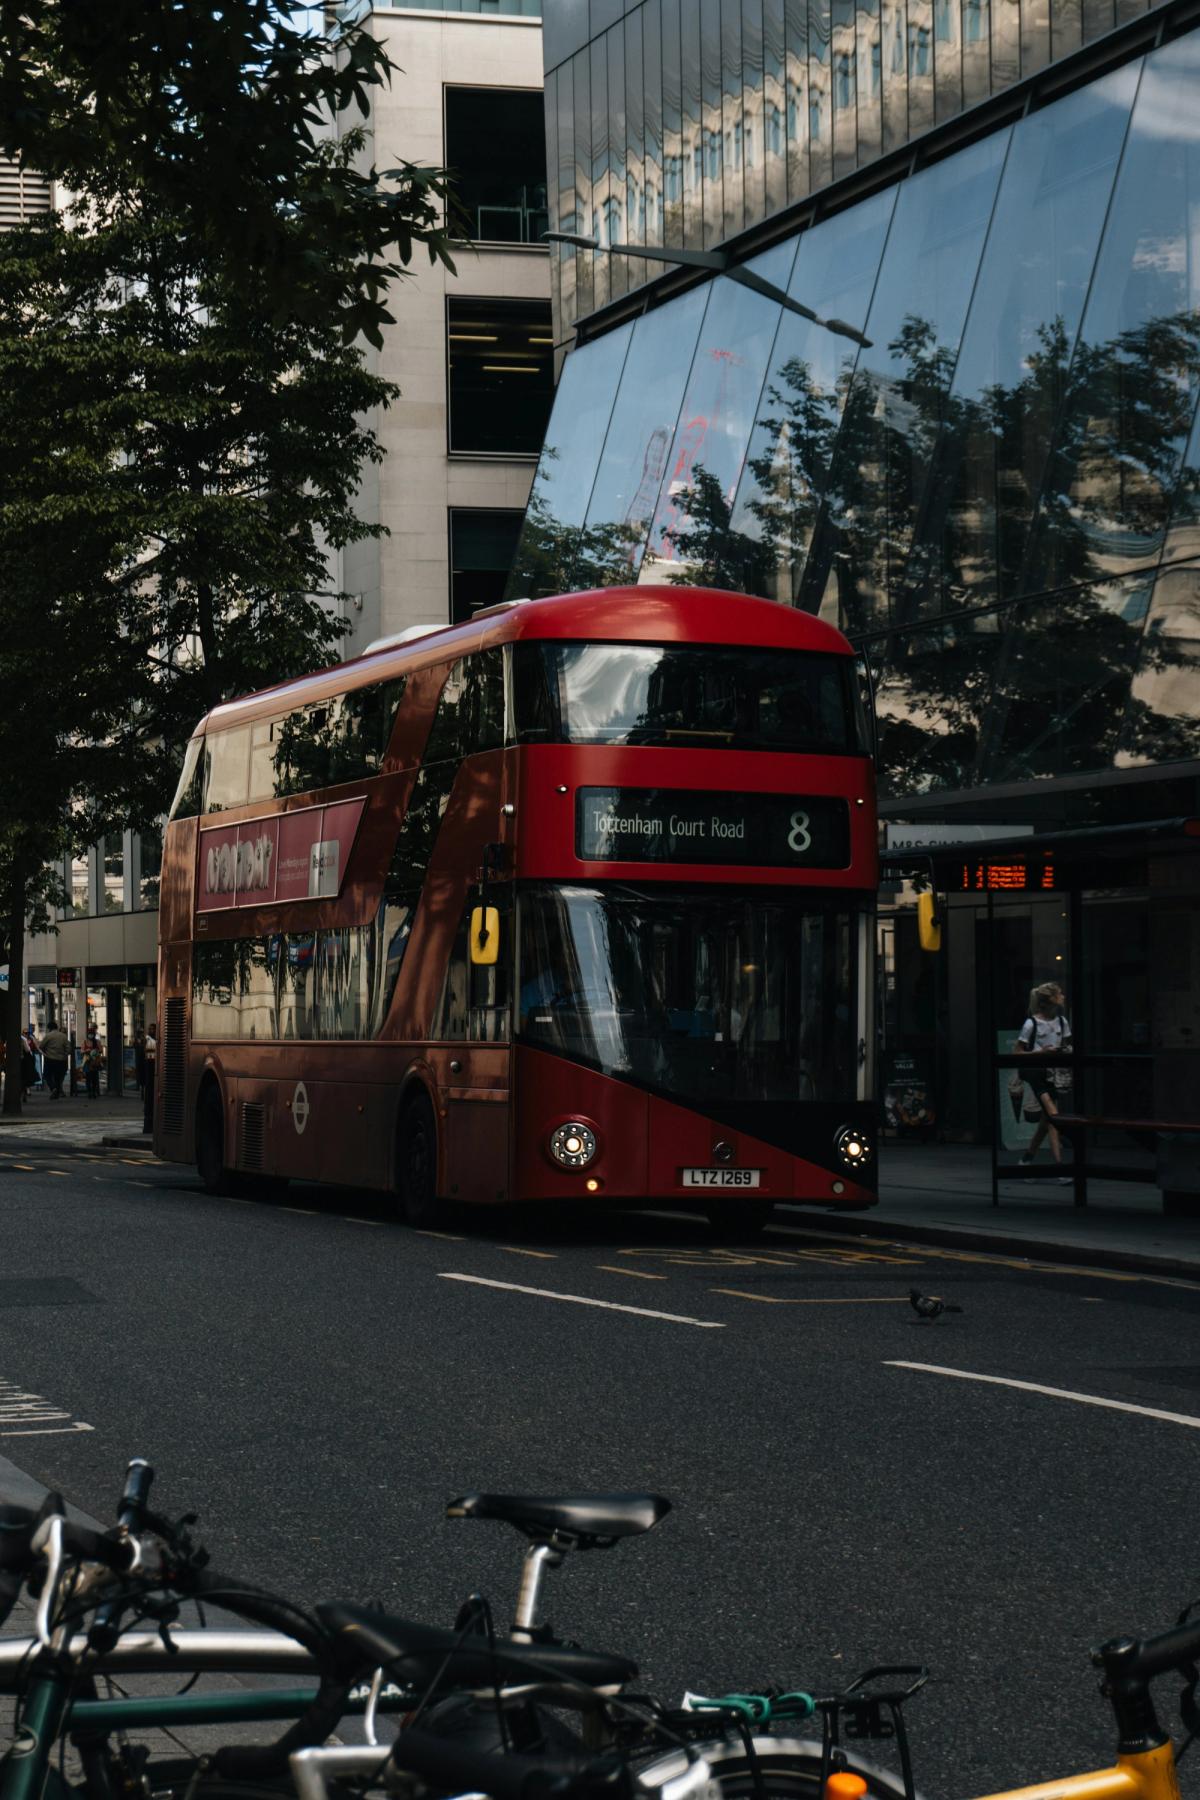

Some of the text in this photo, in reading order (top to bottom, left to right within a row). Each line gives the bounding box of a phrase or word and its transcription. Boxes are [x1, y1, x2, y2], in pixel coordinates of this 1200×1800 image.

[593, 811, 745, 839] Tottenham Court Road
[787, 810, 812, 852] 8
[691, 1171, 752, 1185] LTZ 1269
